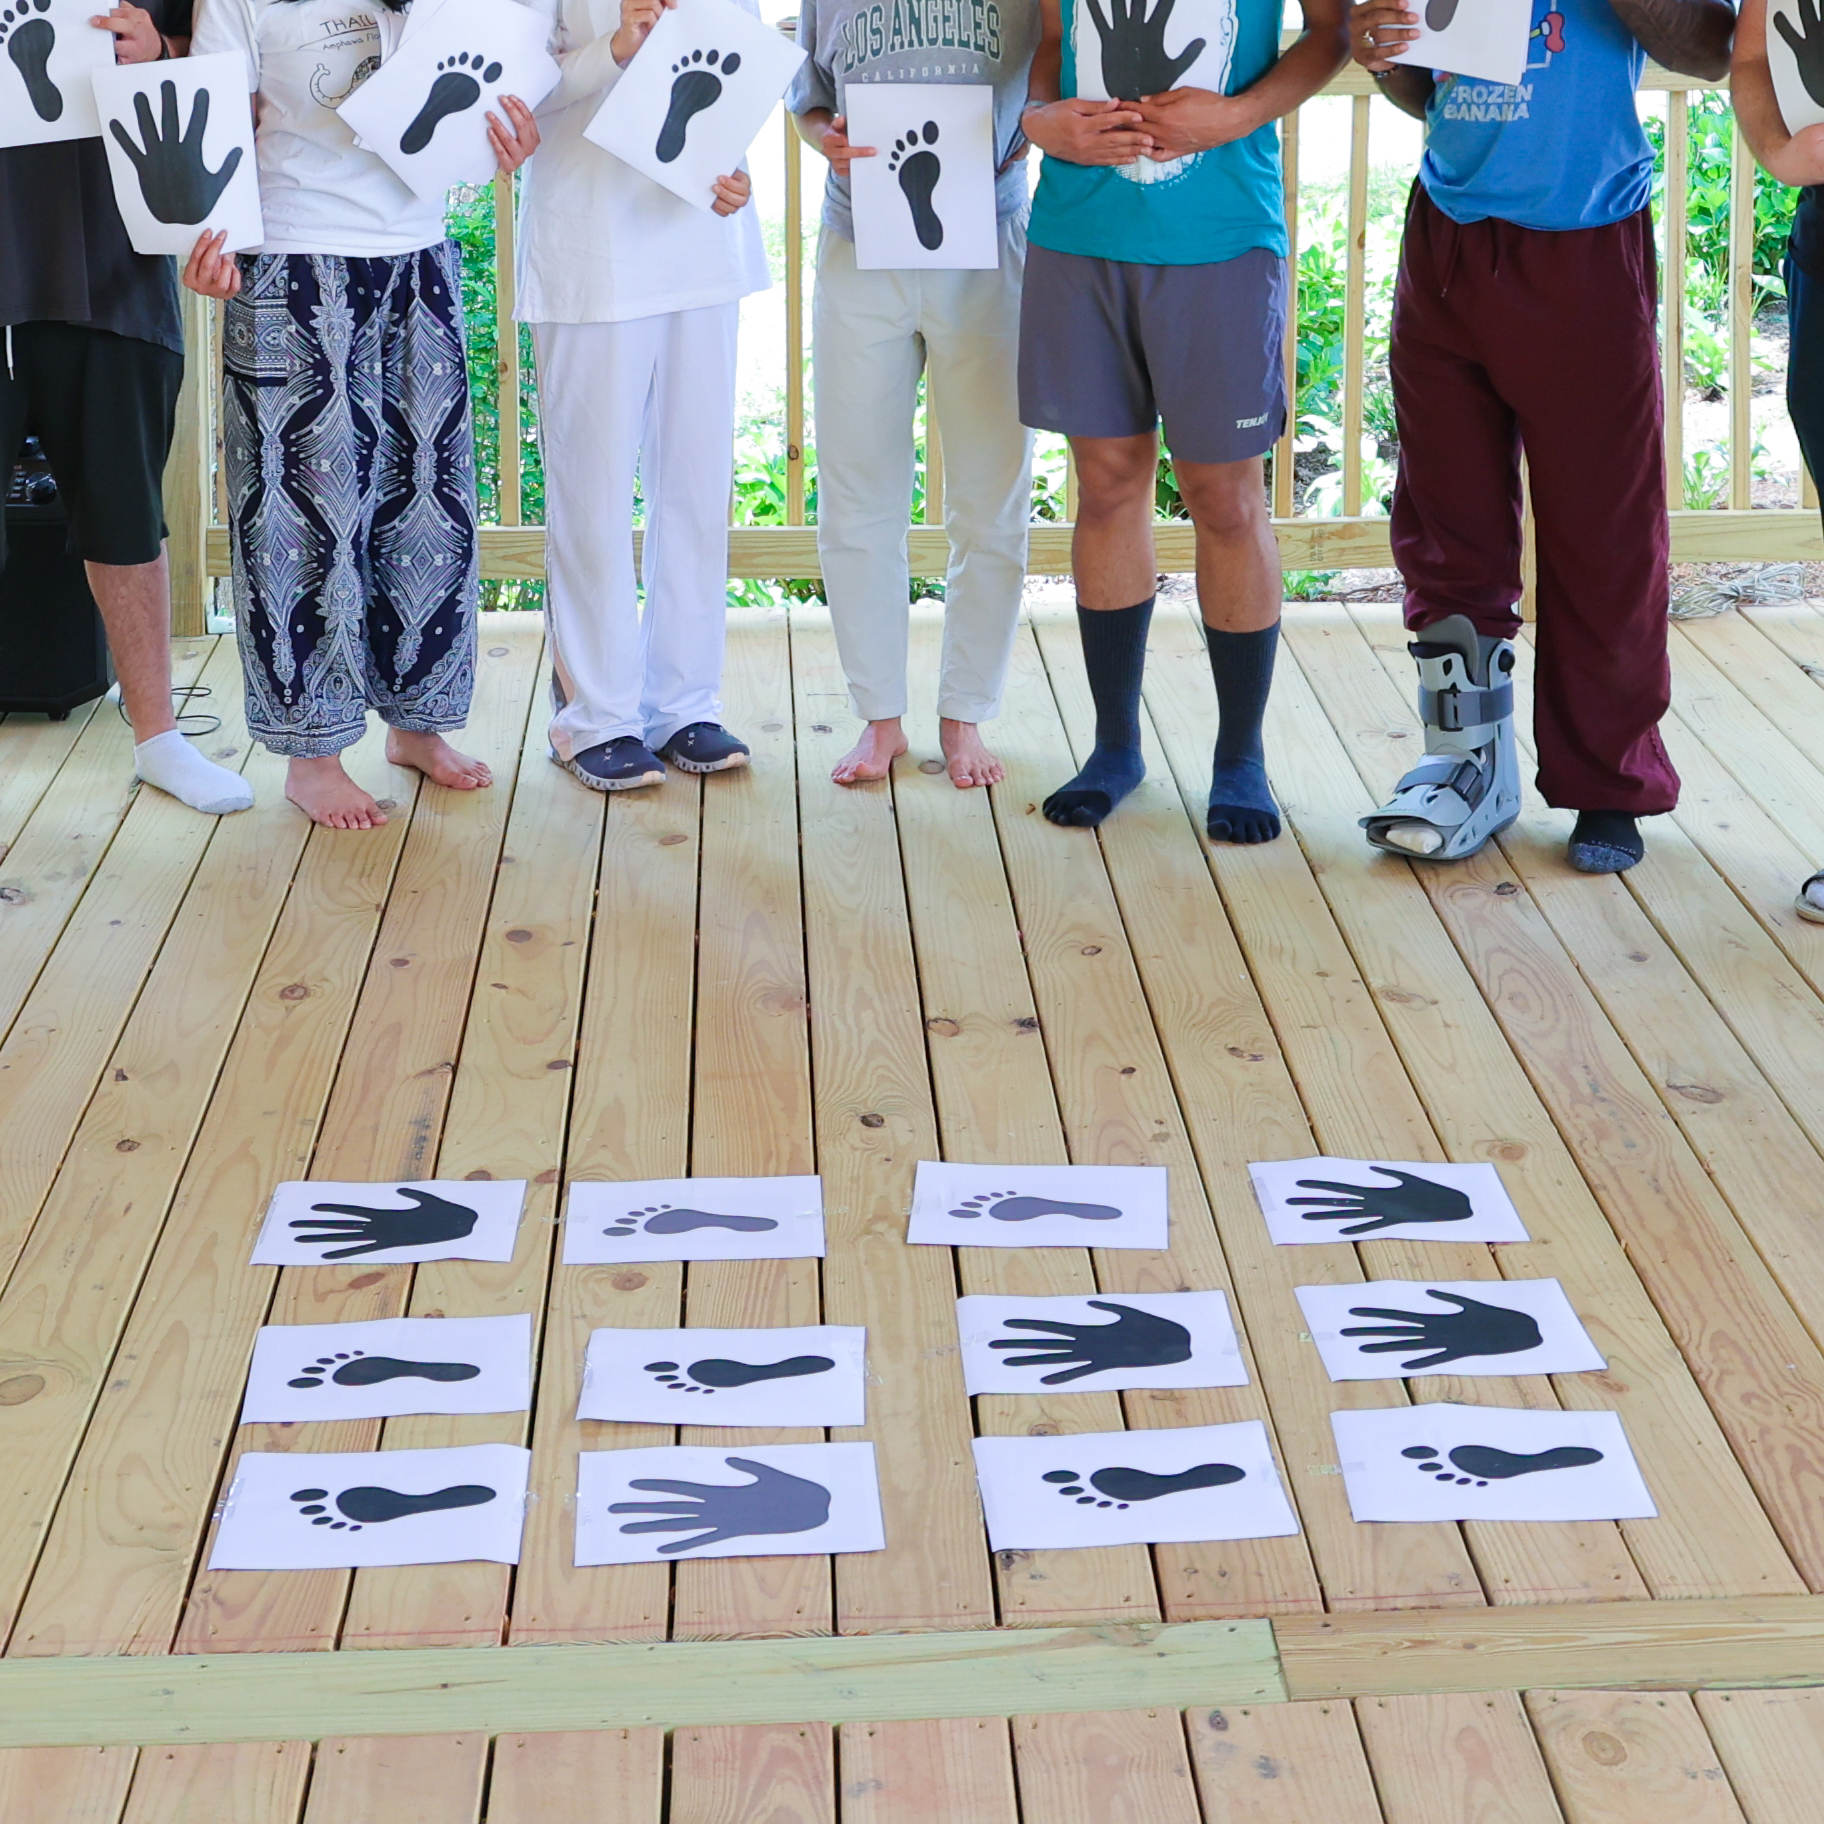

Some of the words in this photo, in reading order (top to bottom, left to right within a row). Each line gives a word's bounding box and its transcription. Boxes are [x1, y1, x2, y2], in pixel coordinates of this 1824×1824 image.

[840, 2, 885, 76] LOS
[862, 64, 980, 83] CALIFORNIA
[1447, 83, 1534, 104] FROZEN
[1443, 102, 1530, 123] BANANA
